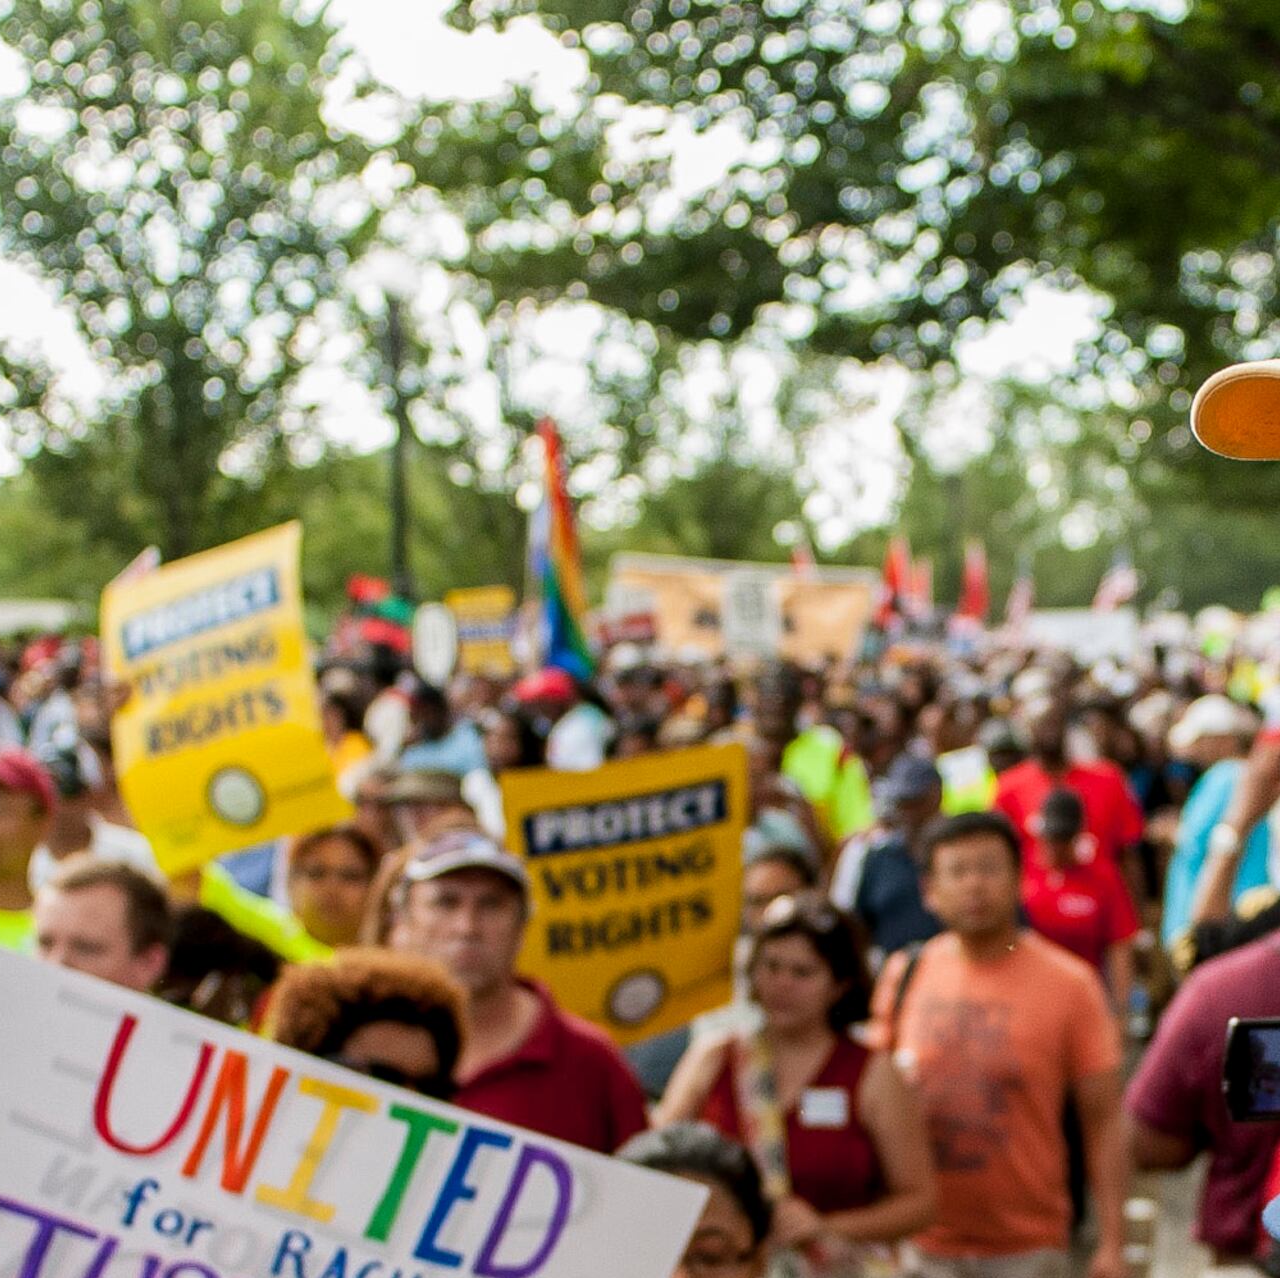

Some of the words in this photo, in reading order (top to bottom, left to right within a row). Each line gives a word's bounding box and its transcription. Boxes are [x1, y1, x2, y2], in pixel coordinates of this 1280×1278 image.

[127, 572, 277, 658] PROTECT
[139, 628, 277, 696] VOTING
[145, 685, 291, 757] RIGHTS
[532, 783, 718, 856] PROTECT
[540, 841, 717, 901] VOTING
[546, 893, 715, 955] RIGHTS
[121, 1176, 216, 1248] for
